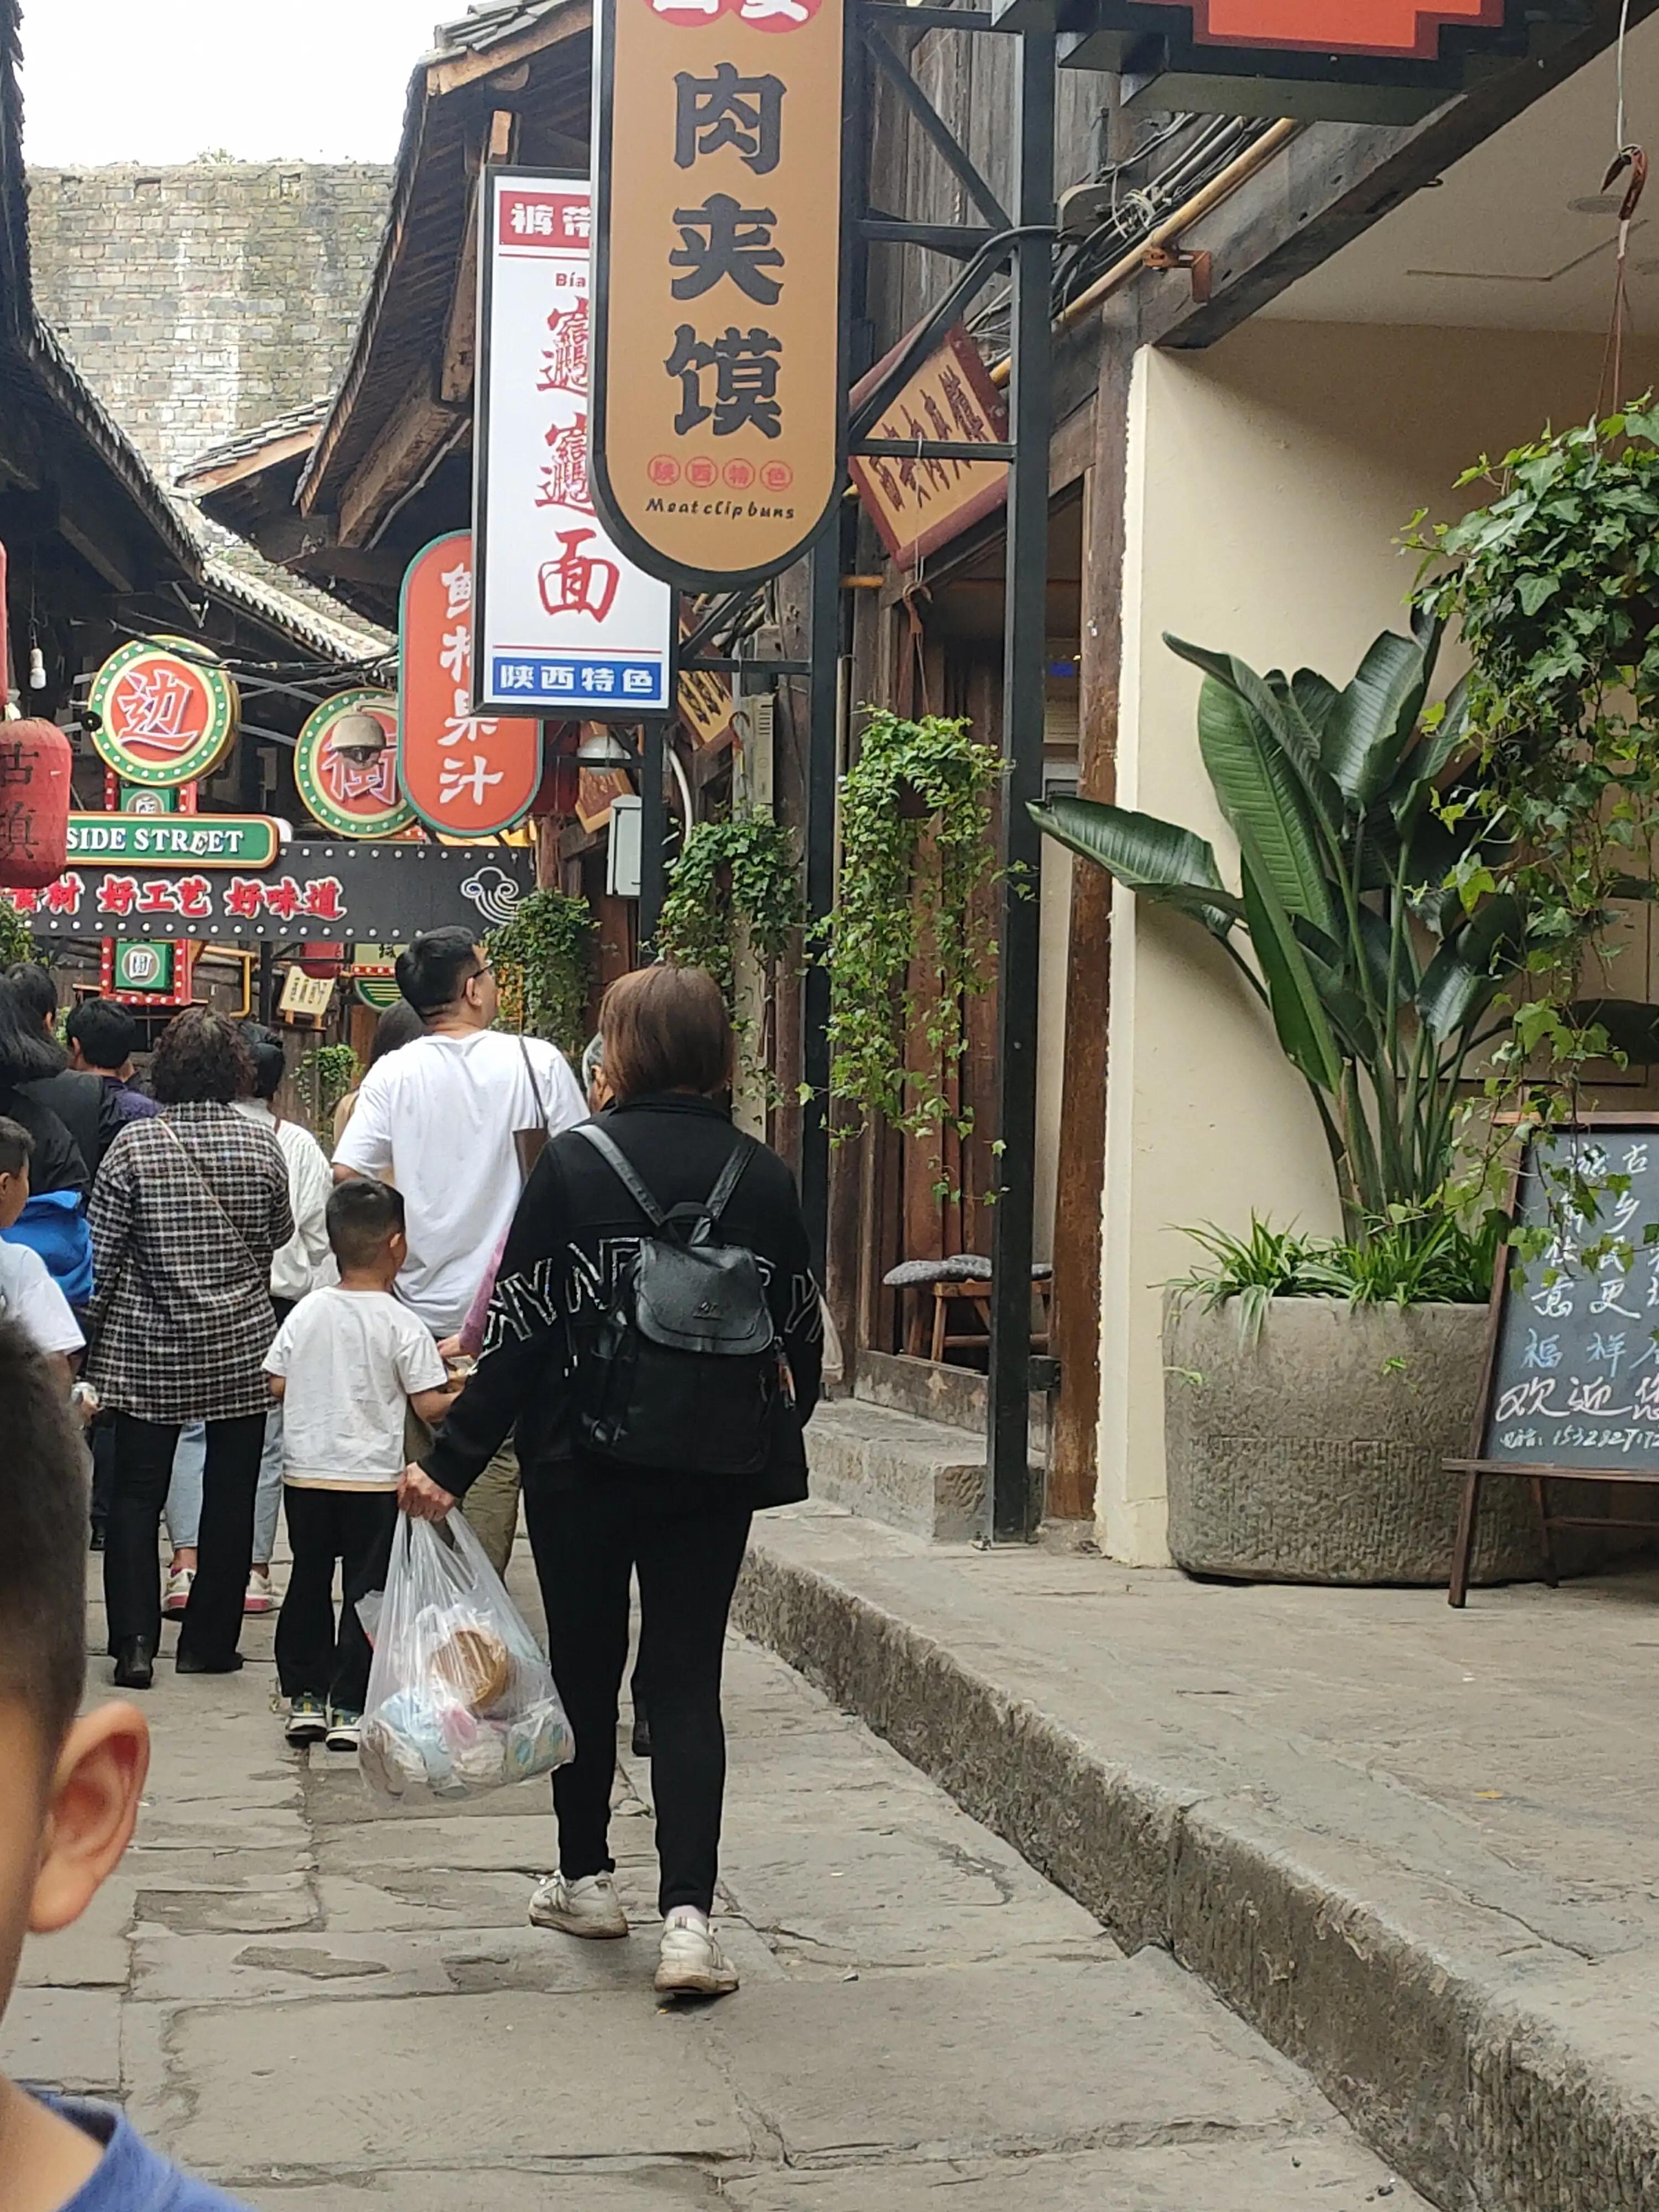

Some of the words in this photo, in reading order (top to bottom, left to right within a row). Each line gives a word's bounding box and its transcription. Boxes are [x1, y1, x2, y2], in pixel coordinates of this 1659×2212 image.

[663, 62, 787, 439] 肉夹馍
[649, 458, 790, 489] 陕西特色
[500, 664, 654, 693] 陕西特色
[117, 669, 200, 752] 边
[134, 828, 244, 856] STREET
[96, 874, 213, 918] 好工艺
[223, 875, 347, 921] 好味道
